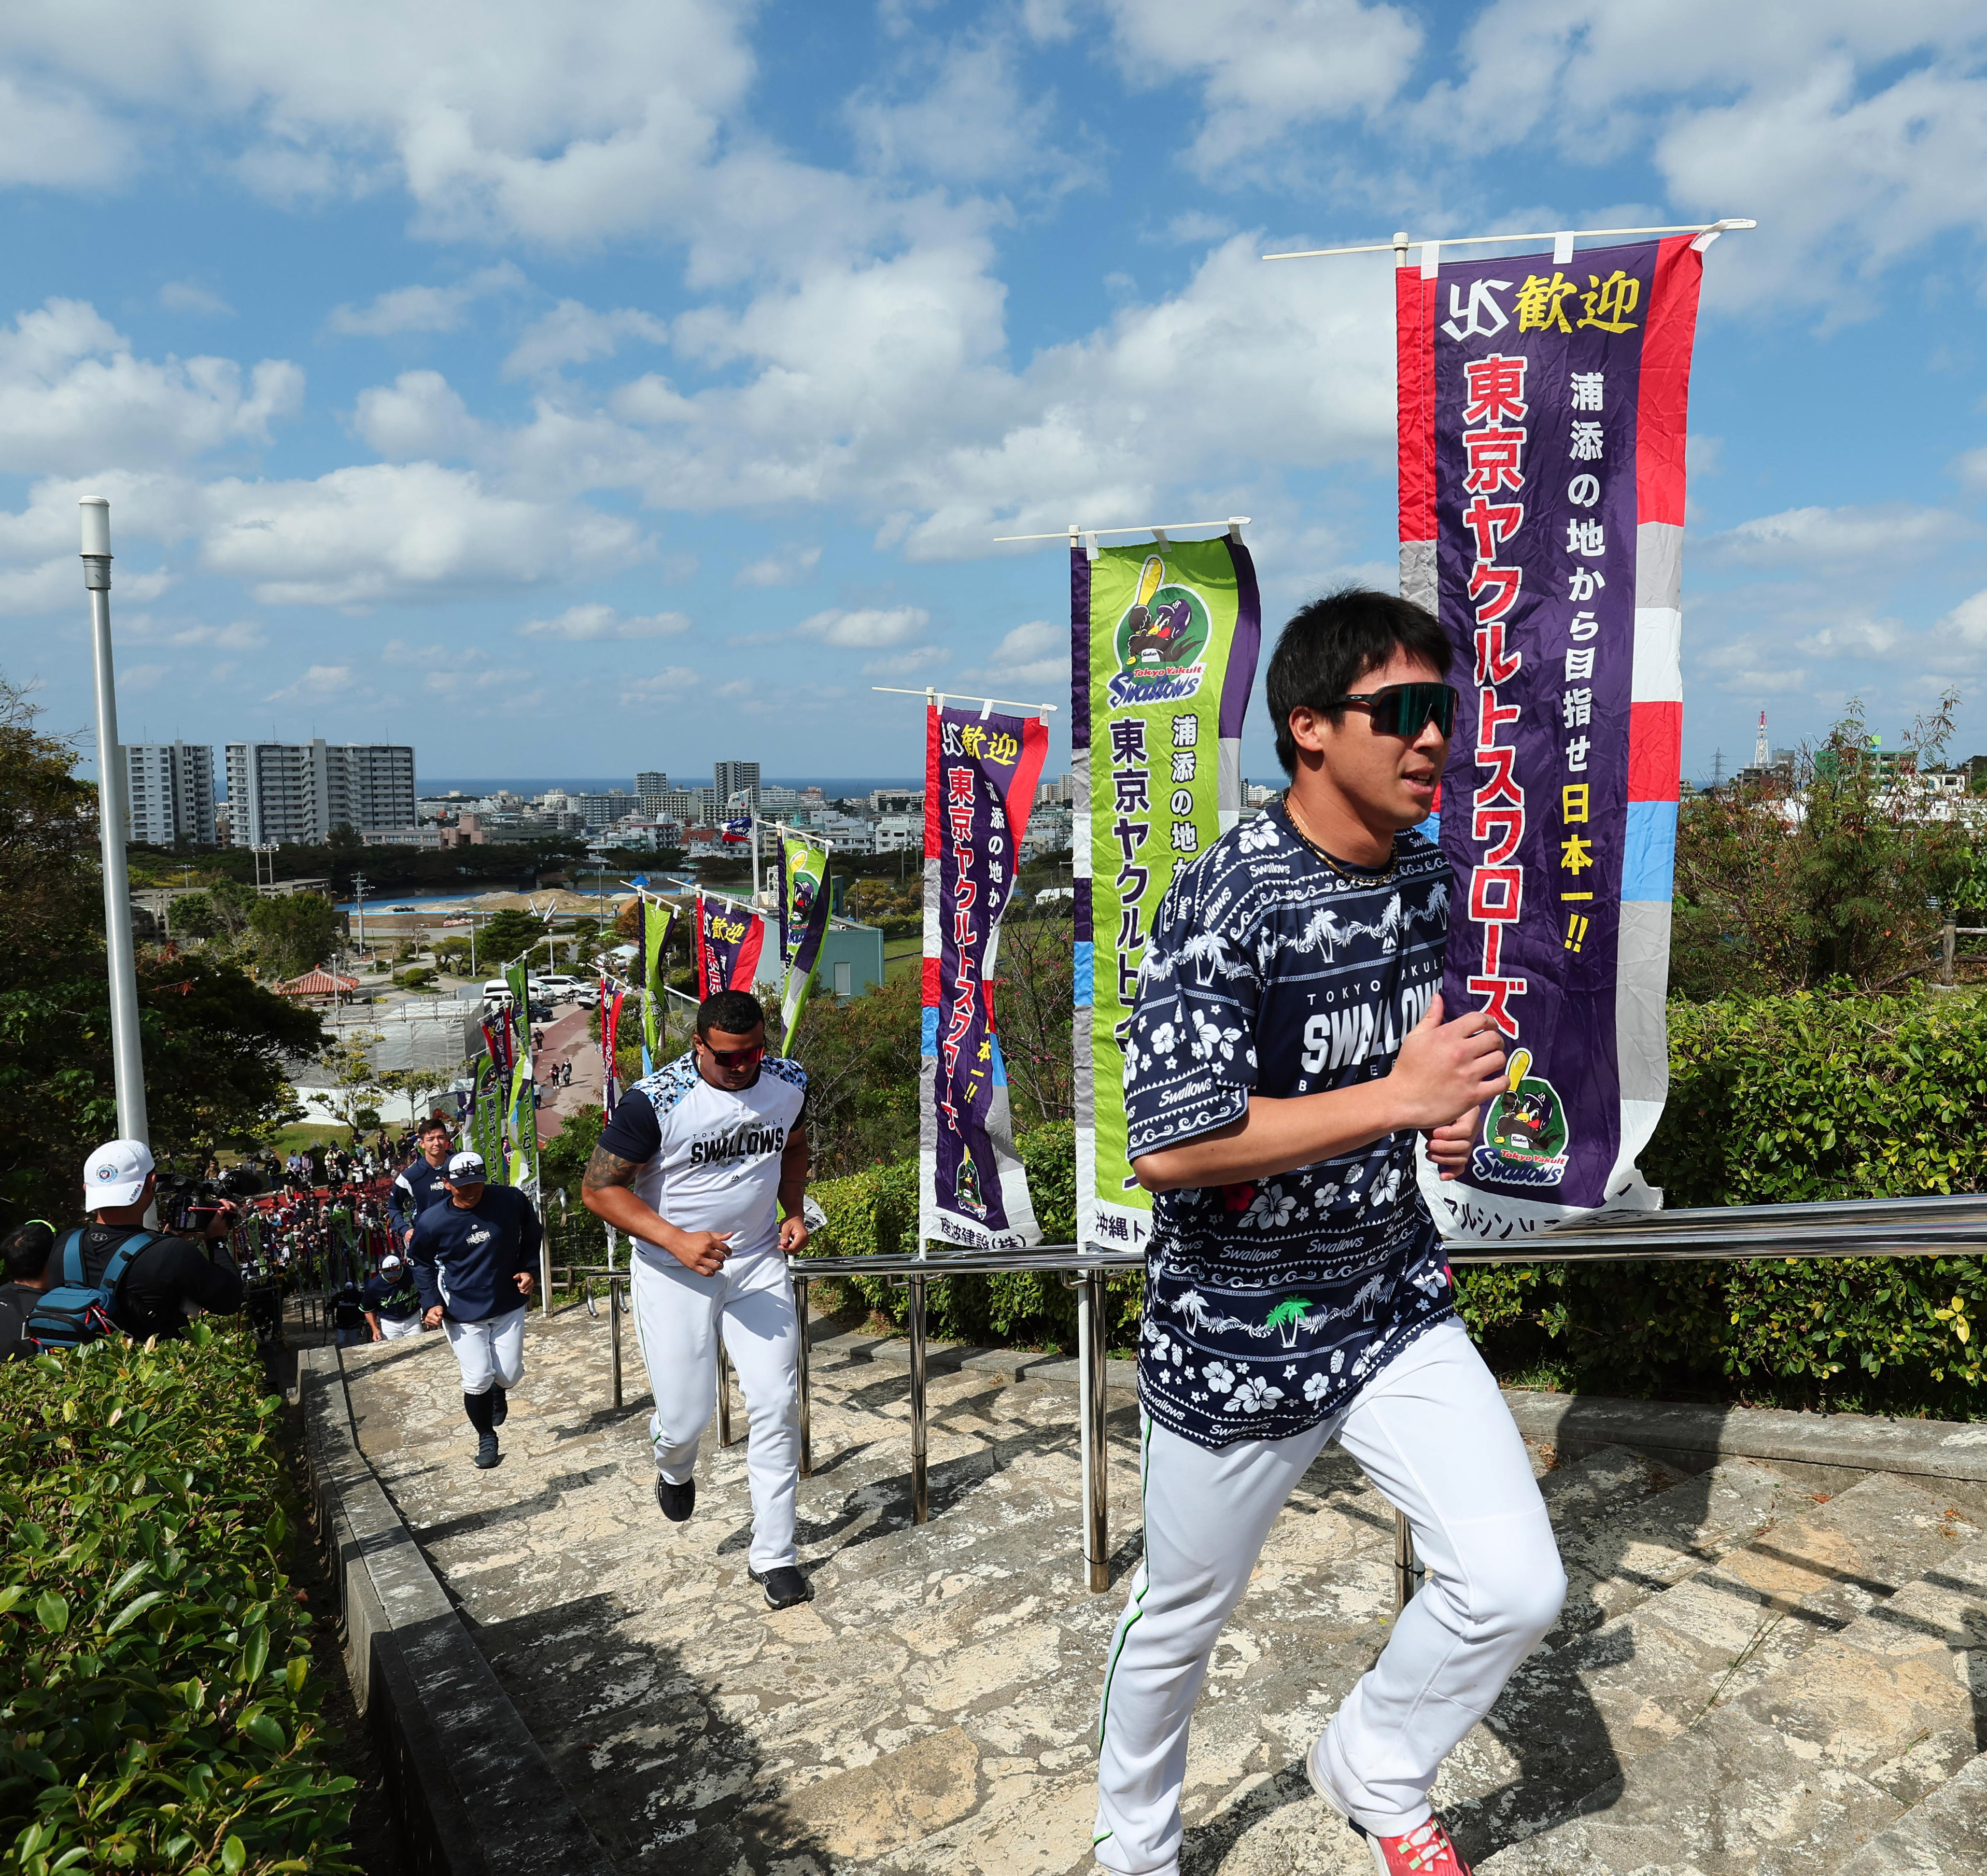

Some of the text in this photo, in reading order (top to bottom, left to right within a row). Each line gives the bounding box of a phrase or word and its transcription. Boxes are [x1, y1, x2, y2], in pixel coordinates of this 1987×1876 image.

[1512, 270, 1640, 334] 歓迎
[1133, 666, 1202, 678] Tokyo Yakult
[1108, 671, 1200, 709] Swallows
[961, 724, 1018, 766] 歓迎
[711, 915, 745, 944] 歓迎
[1307, 956, 1444, 1006] TOKYO AKULT
[1158, 1077, 1212, 1107] Swallows
[693, 1118, 784, 1139] TOKYO YAKULT
[690, 1126, 784, 1164] SWALLOWS
[1500, 1149, 1566, 1165] Tokyo Yakult
[1474, 1147, 1562, 1183] Swallows
[1219, 1245, 1281, 1262] Swallows
[1306, 1236, 1363, 1253] Swallows
[1209, 1422, 1272, 1436] Swallows
